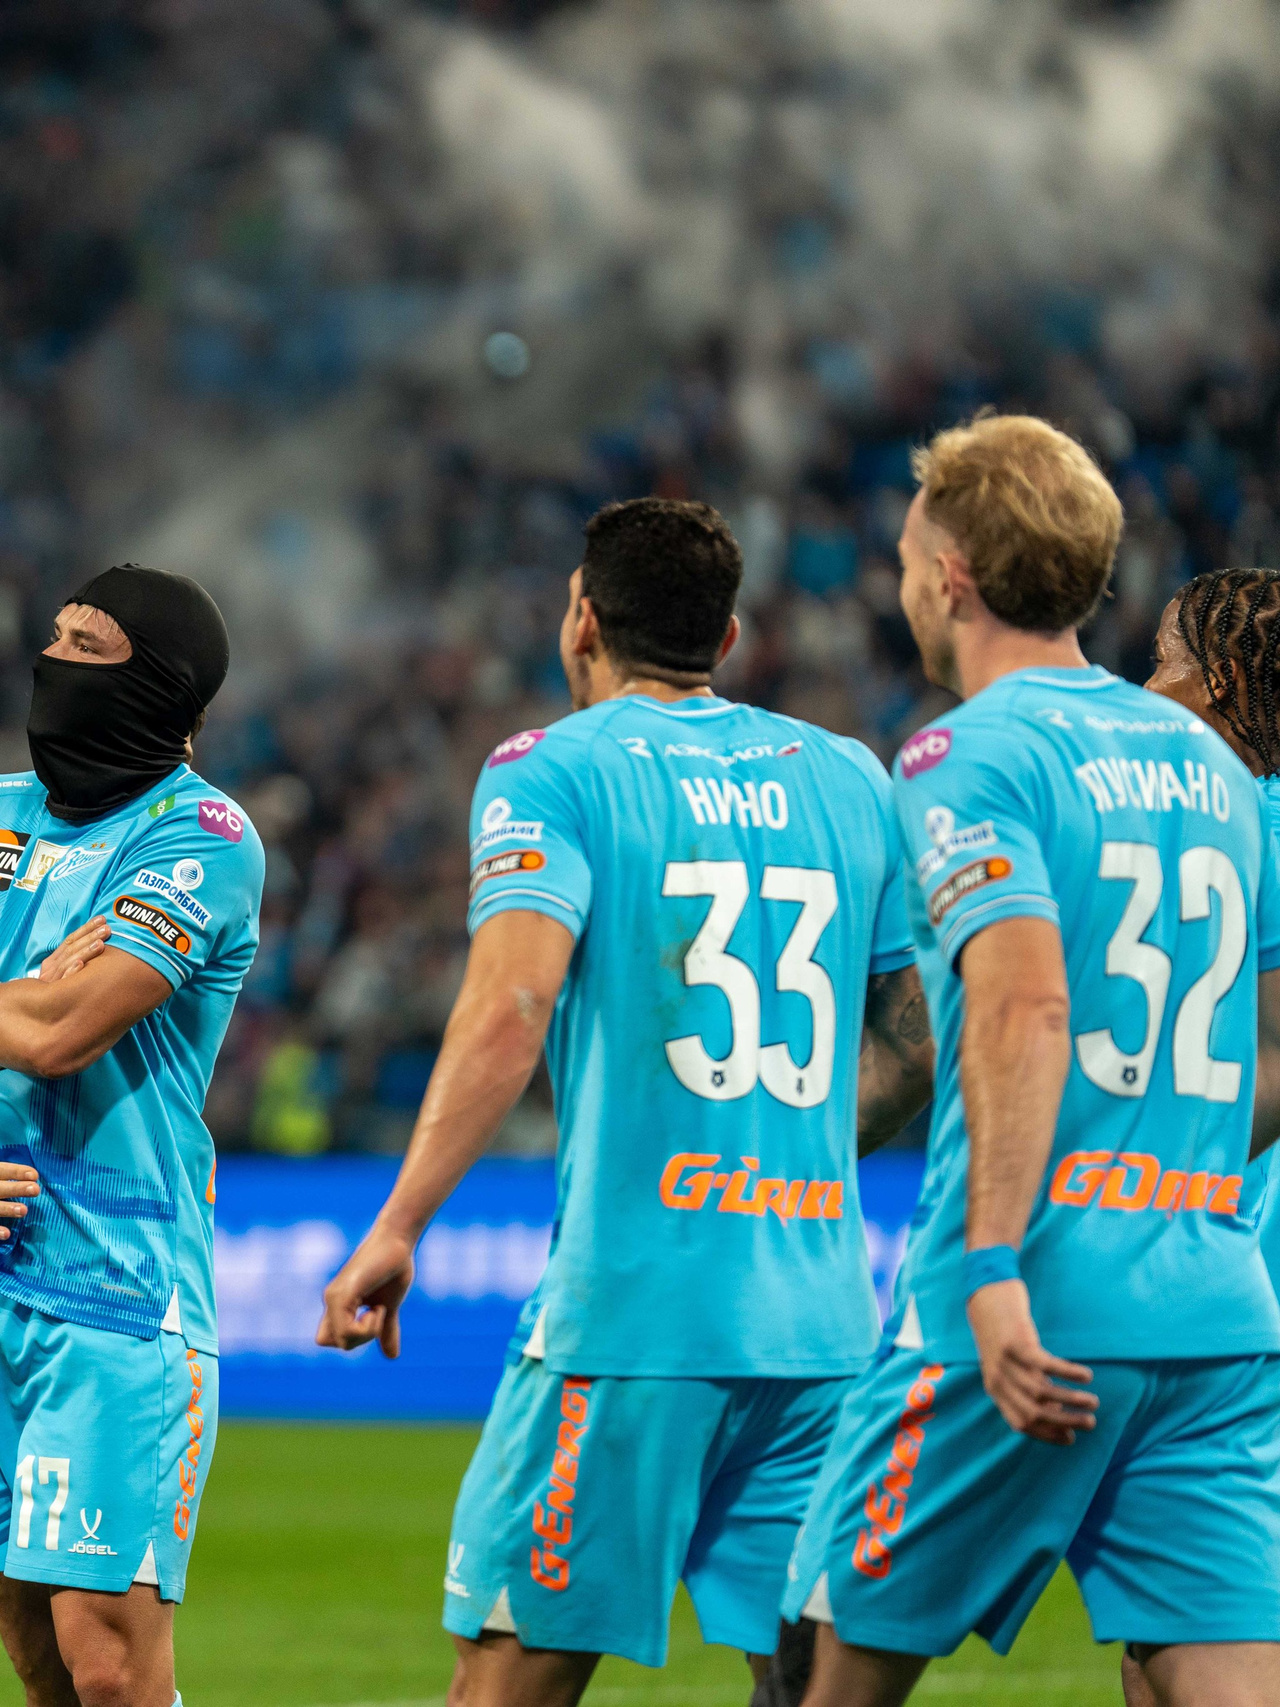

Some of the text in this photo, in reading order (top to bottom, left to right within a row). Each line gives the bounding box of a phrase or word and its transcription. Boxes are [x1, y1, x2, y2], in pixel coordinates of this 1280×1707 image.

[201, 806, 242, 832] wb
[679, 777, 789, 830] НИНО
[119, 901, 179, 942] WINLINE
[137, 871, 209, 926] ГАЗПРОМБАНК
[661, 860, 838, 1109] 33
[1075, 842, 1247, 1103] 32
[15, 1455, 71, 1551] 17
[67, 1540, 118, 1556] JÖGEL
